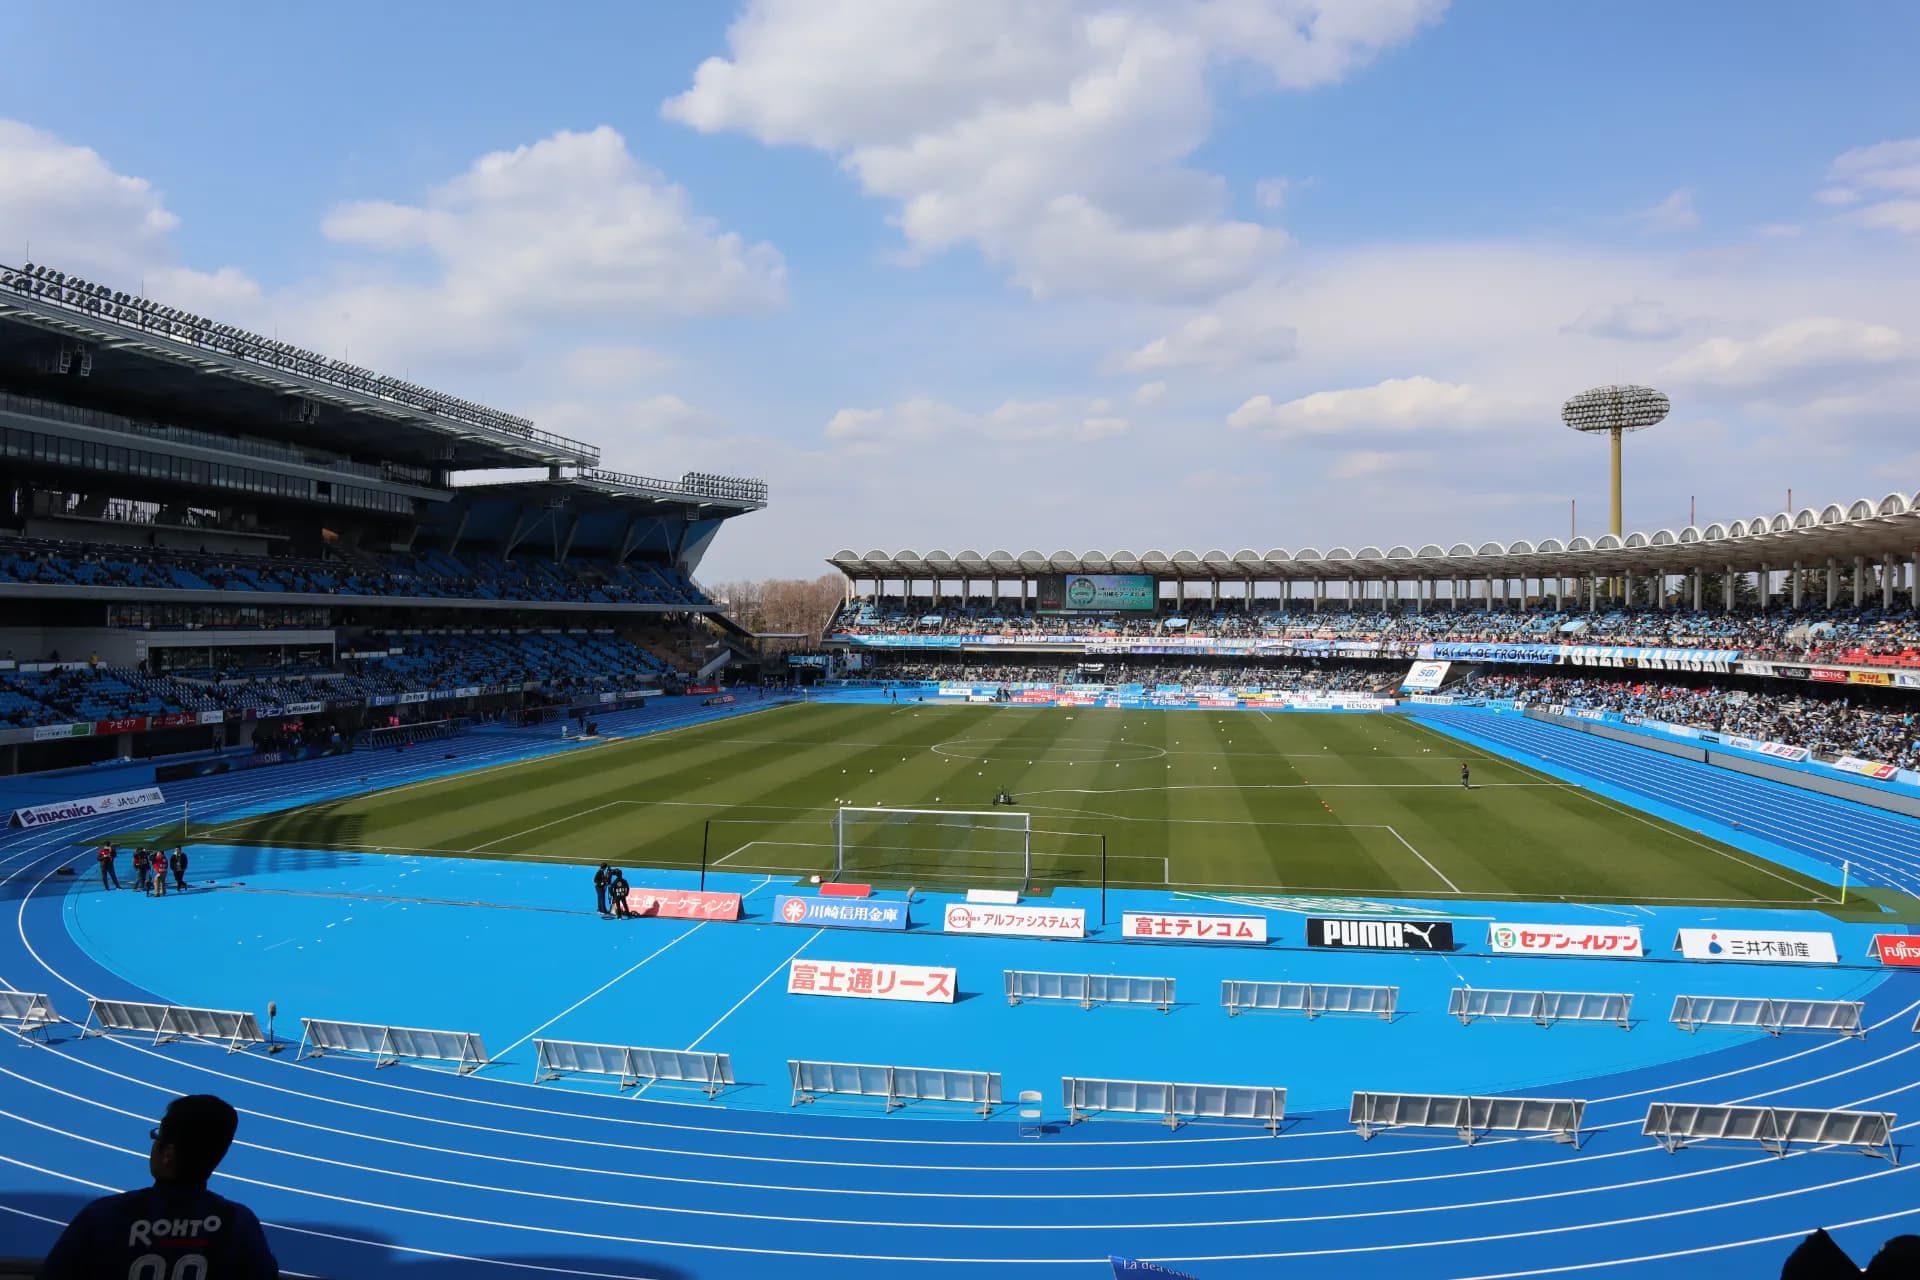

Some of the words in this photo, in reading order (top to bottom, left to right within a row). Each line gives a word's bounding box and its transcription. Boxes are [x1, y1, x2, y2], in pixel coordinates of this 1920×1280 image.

[1556, 645, 1624, 668] FORZA
[1637, 649, 1733, 673] KAWASAKI
[1417, 668, 1438, 677] SBI
[1858, 674, 1882, 684] DHL
[108, 719, 136, 729] アゼリア
[627, 894, 737, 914] 士通マーケティング
[807, 904, 899, 923] 川崎信用金庫
[983, 912, 1081, 929] アルファシステムズ
[1135, 916, 1254, 938] 富士テレコム
[1324, 920, 1405, 947] PUMA
[1730, 939, 1810, 958] 三井不動産
[791, 962, 952, 998] 富士通リース
[128, 1215, 222, 1247] ROHTO
